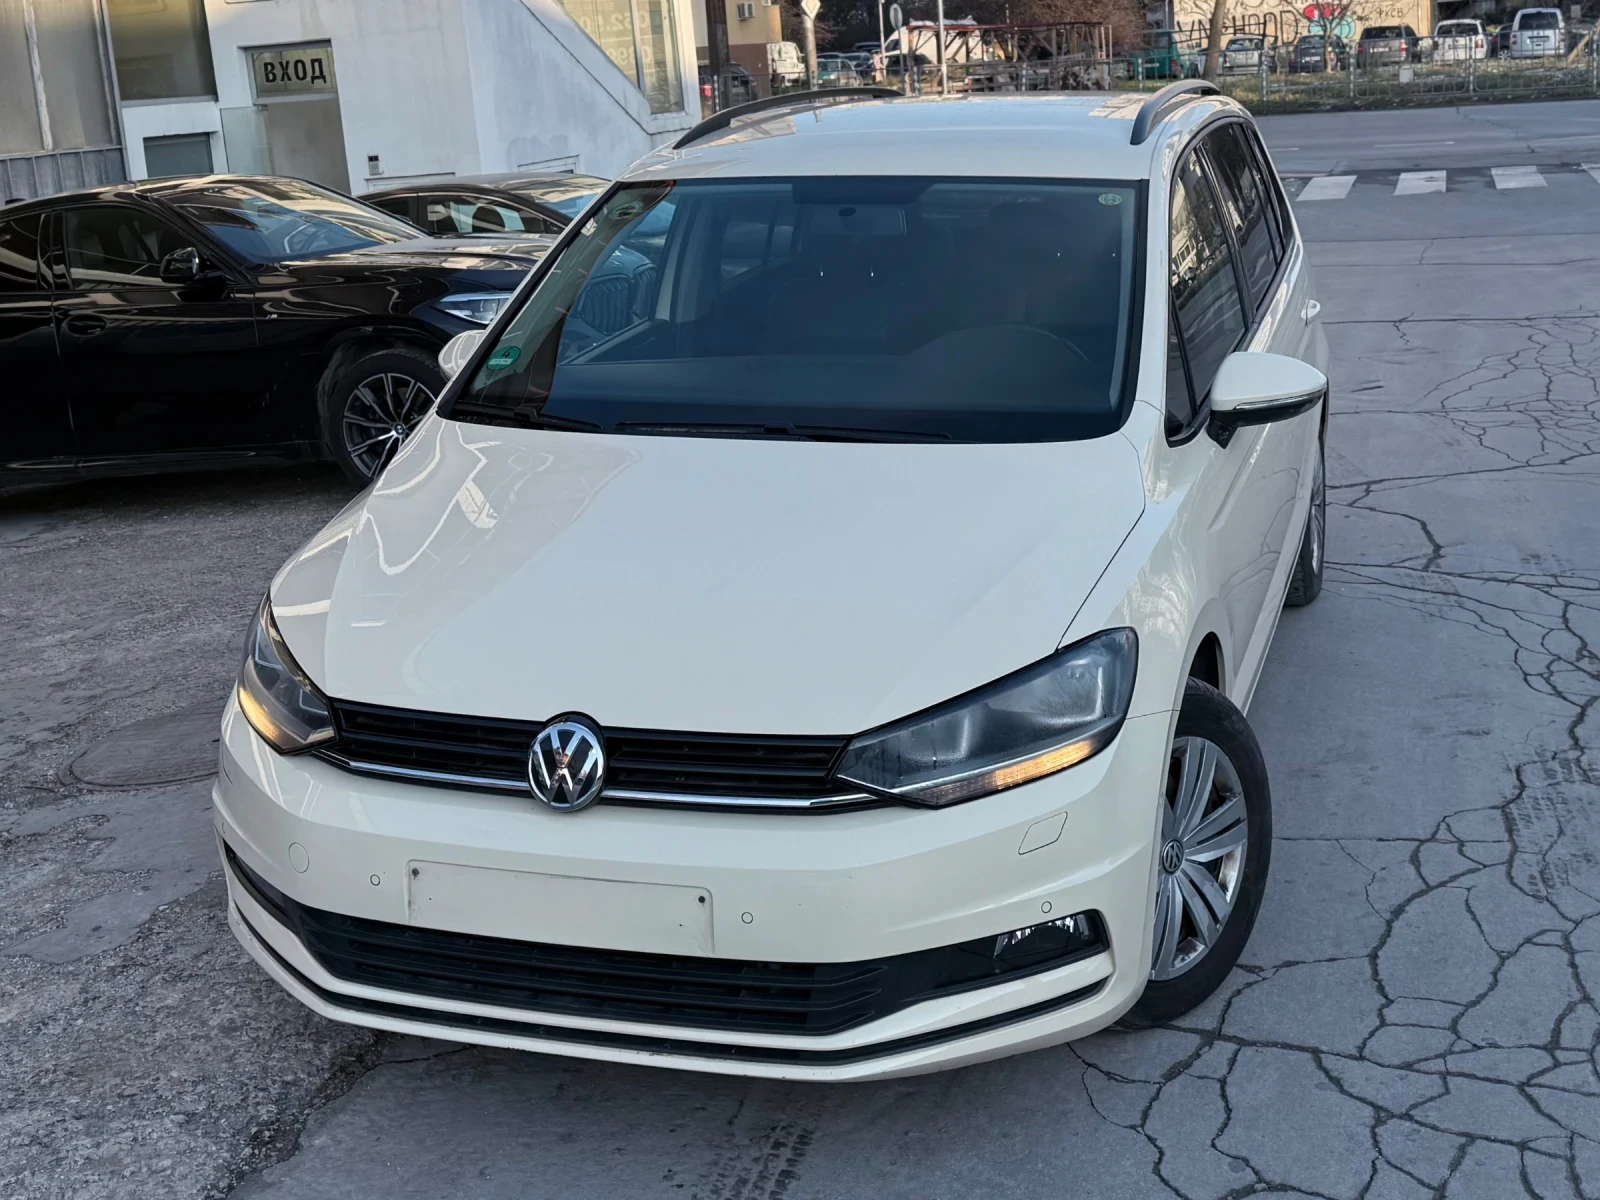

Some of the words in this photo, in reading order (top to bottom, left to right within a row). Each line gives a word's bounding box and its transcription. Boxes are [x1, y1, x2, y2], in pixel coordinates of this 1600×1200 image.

[263, 58, 326, 84] ВХОД
[501, 346, 513, 358] 4
[529, 721, 603, 809] VW
